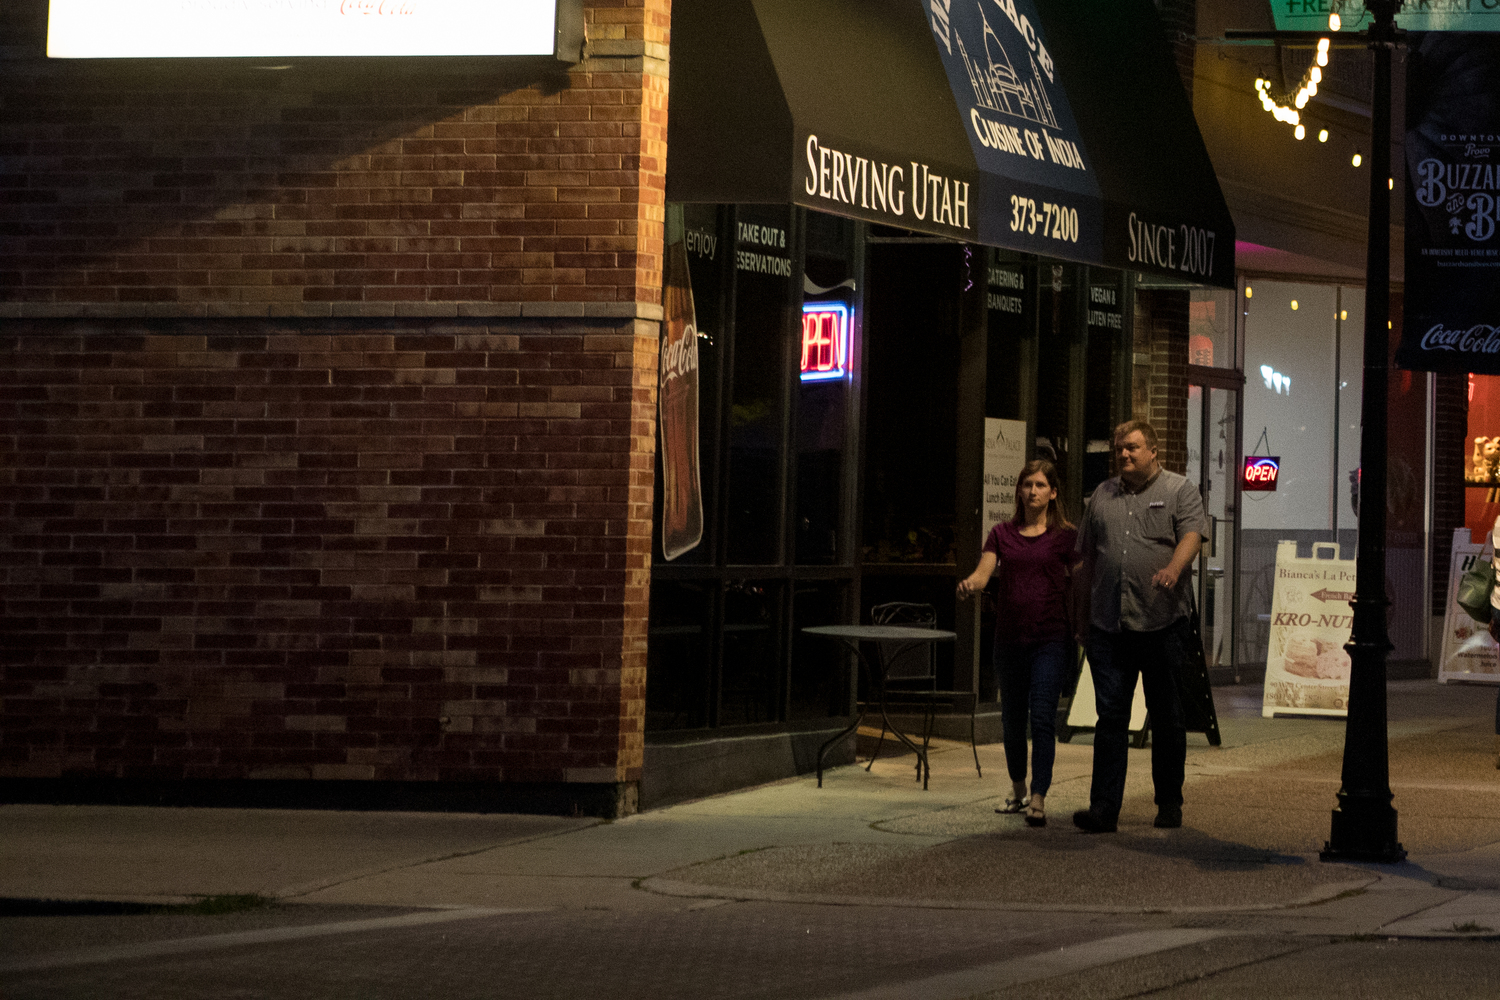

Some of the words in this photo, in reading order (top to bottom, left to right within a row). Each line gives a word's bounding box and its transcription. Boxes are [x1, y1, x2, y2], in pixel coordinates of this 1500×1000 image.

[970, 107, 1028, 158] CUISINE
[1023, 128, 1046, 161] OF
[1041, 128, 1087, 171] INDIA
[1463, 142, 1491, 158] Provo
[805, 134, 905, 216] SERVING
[910, 161, 971, 230] UTAH
[1445, 192, 1465, 215] and
[1009, 194, 1079, 244] 373-7200
[686, 226, 718, 261] enjoy
[737, 221, 760, 244] TAKE
[760, 225, 779, 247] OUT
[779, 229, 786, 249] &
[1127, 211, 1177, 270] SINCE
[1179, 223, 1216, 278] 2007
[736, 250, 792, 278] ESERVATIONS
[987, 292, 1022, 315] BANQUETS
[1090, 285, 1110, 305] VEGAN
[1087, 309, 1107, 327] LUTEN
[1107, 312, 1122, 330] FREE
[992, 474, 1000, 486] You
[1000, 475, 1009, 487] Can
[1245, 465, 1278, 482] OPEN
[986, 492, 1000, 504] Lunch
[1278, 567, 1320, 581] Bianca's
[1323, 570, 1336, 581] La
